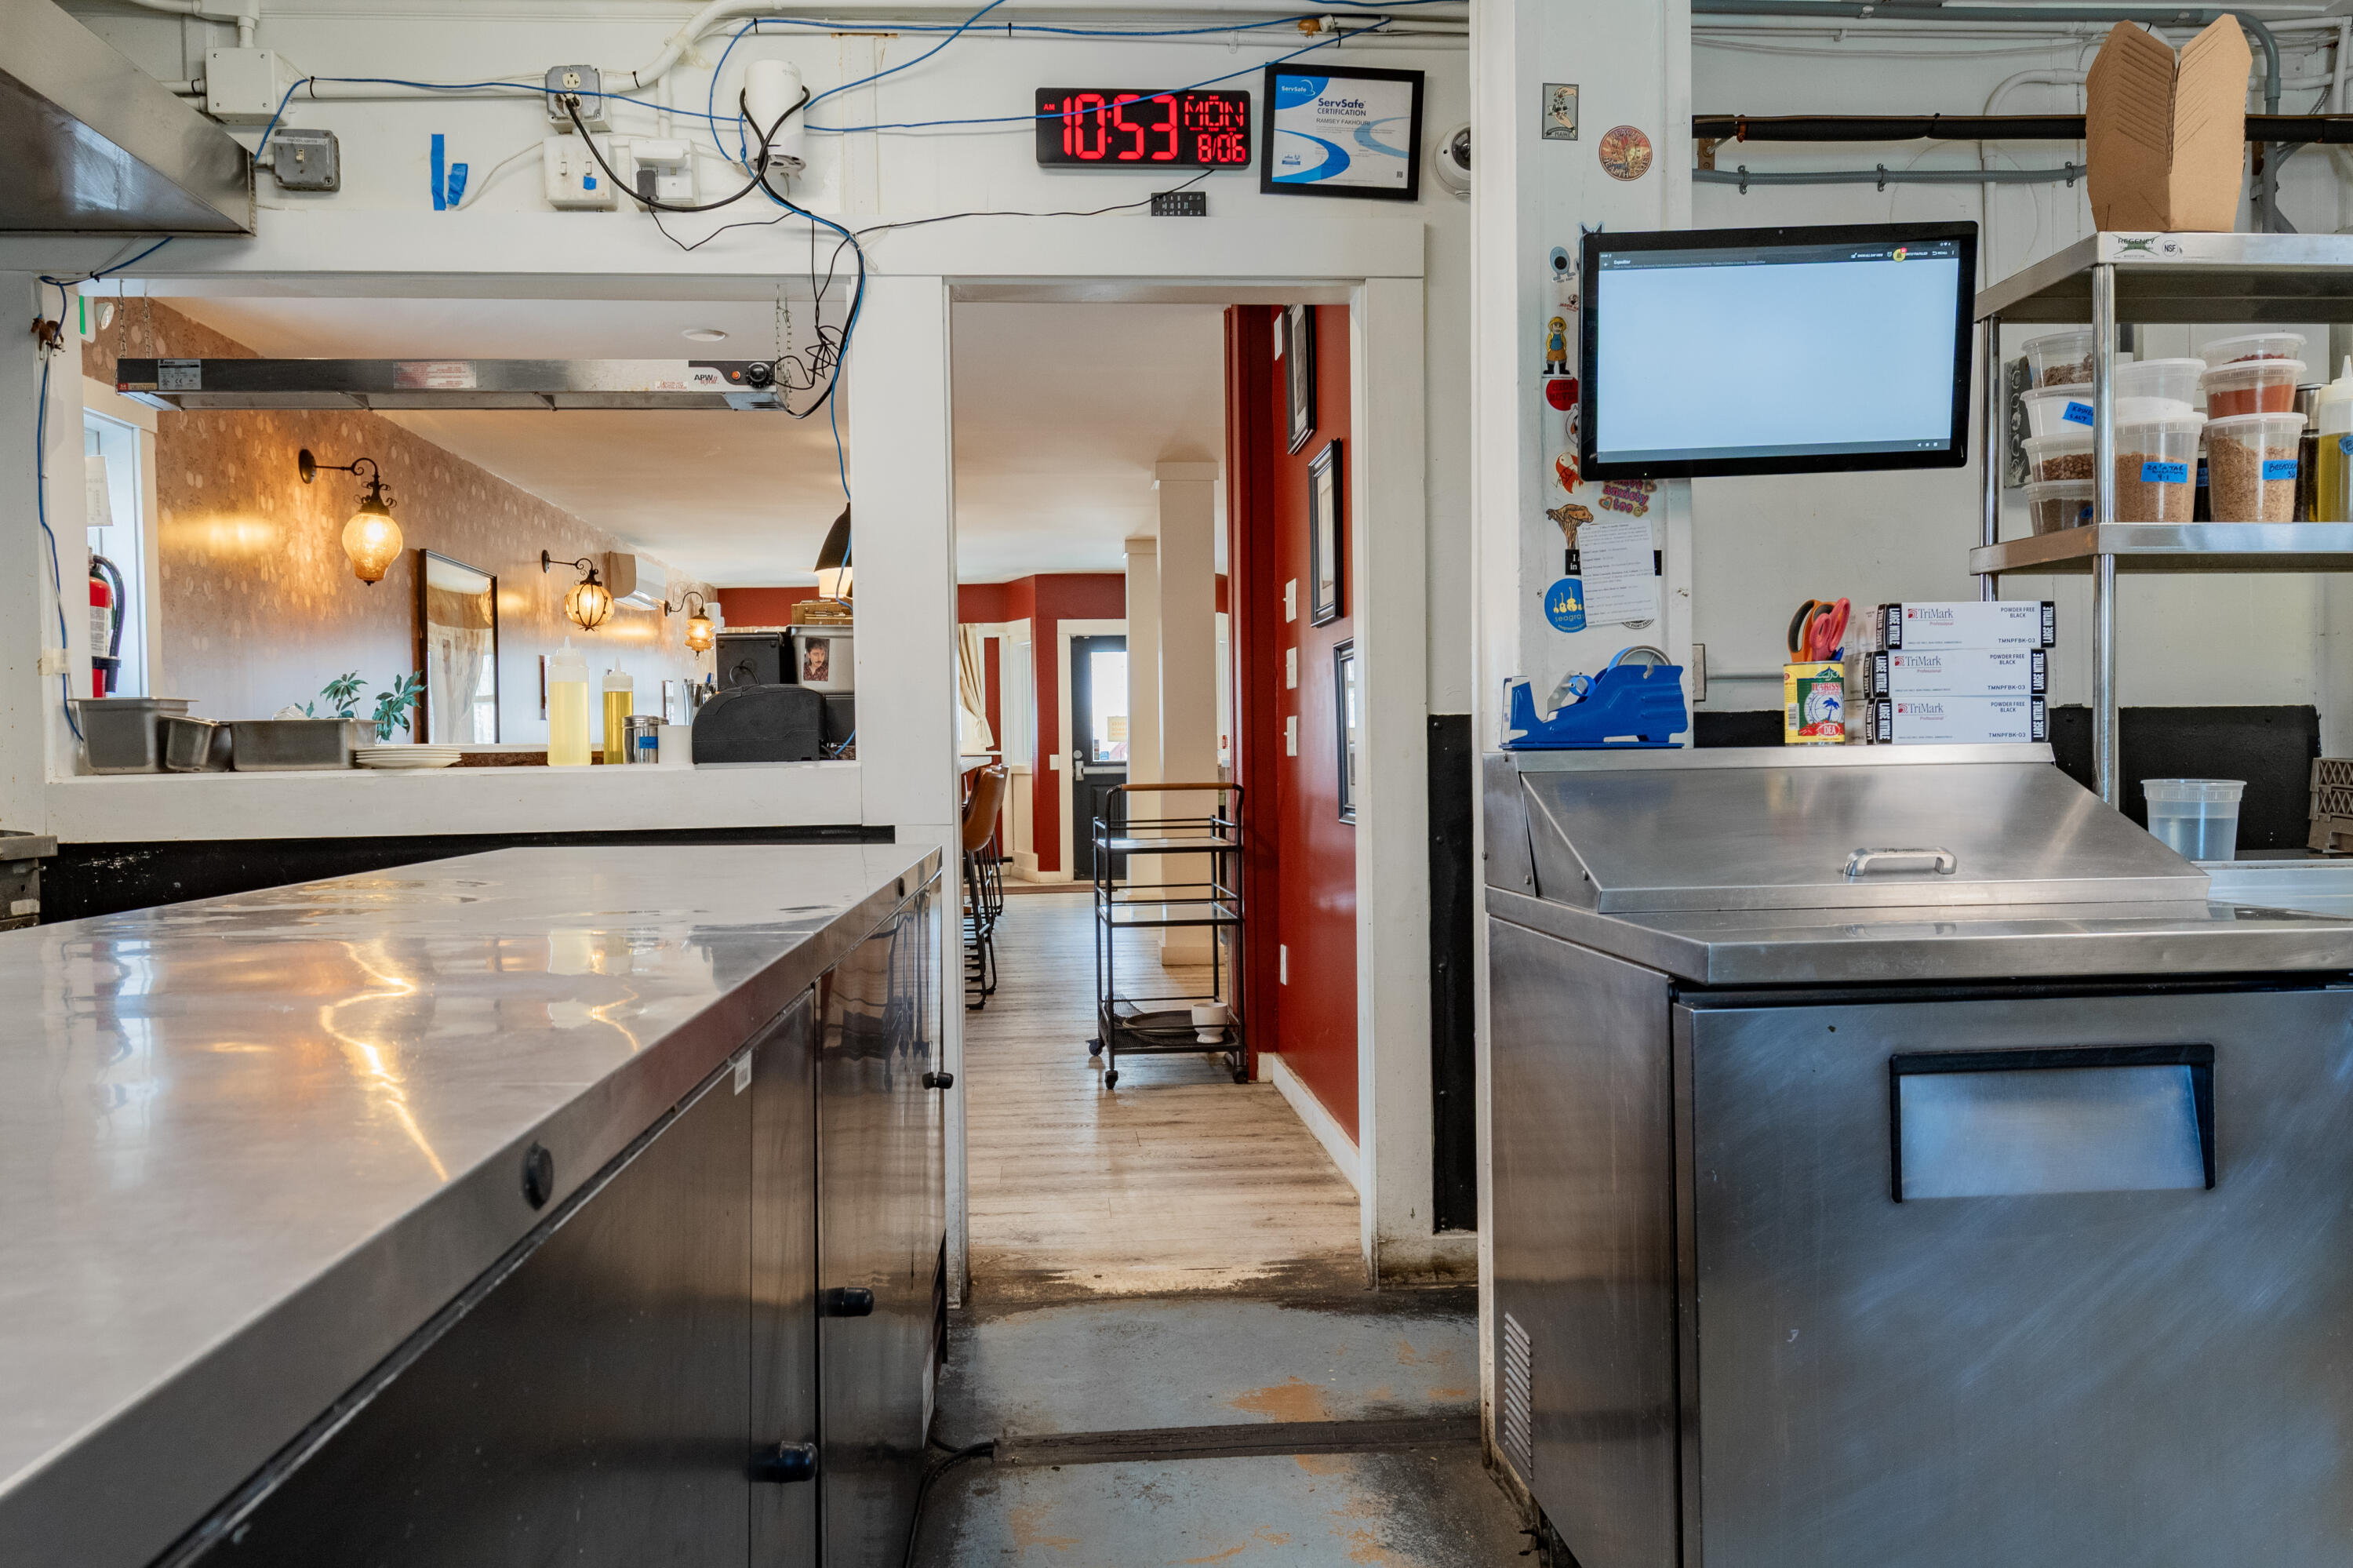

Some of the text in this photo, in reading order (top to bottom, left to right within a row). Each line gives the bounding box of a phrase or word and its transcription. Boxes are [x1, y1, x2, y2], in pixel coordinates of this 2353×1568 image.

[1318, 98, 1365, 109] ServSafe
[1184, 100, 1244, 127] MON
[1317, 108, 1366, 117] CERTIFICATION
[1063, 93, 1178, 160] 10:53
[1198, 133, 1246, 162] 8/06
[2070, 413, 2087, 422] SALT
[1603, 485, 1649, 506] anxiety
[1613, 499, 1634, 513] too
[1889, 608, 1900, 625] LARGE
[1918, 608, 1954, 619] TriMark
[2042, 606, 2054, 643] LARGE NITRILE
[1875, 656, 1888, 673] LARGE
[1905, 656, 1942, 667] TriMark
[2033, 653, 2044, 690] LARGE NITRILE
[1878, 703, 1891, 720] LARGE
[1908, 703, 1944, 714] TriMark
[2033, 700, 2044, 738] LARGE NITRILE
[1824, 726, 1836, 734] DEA
